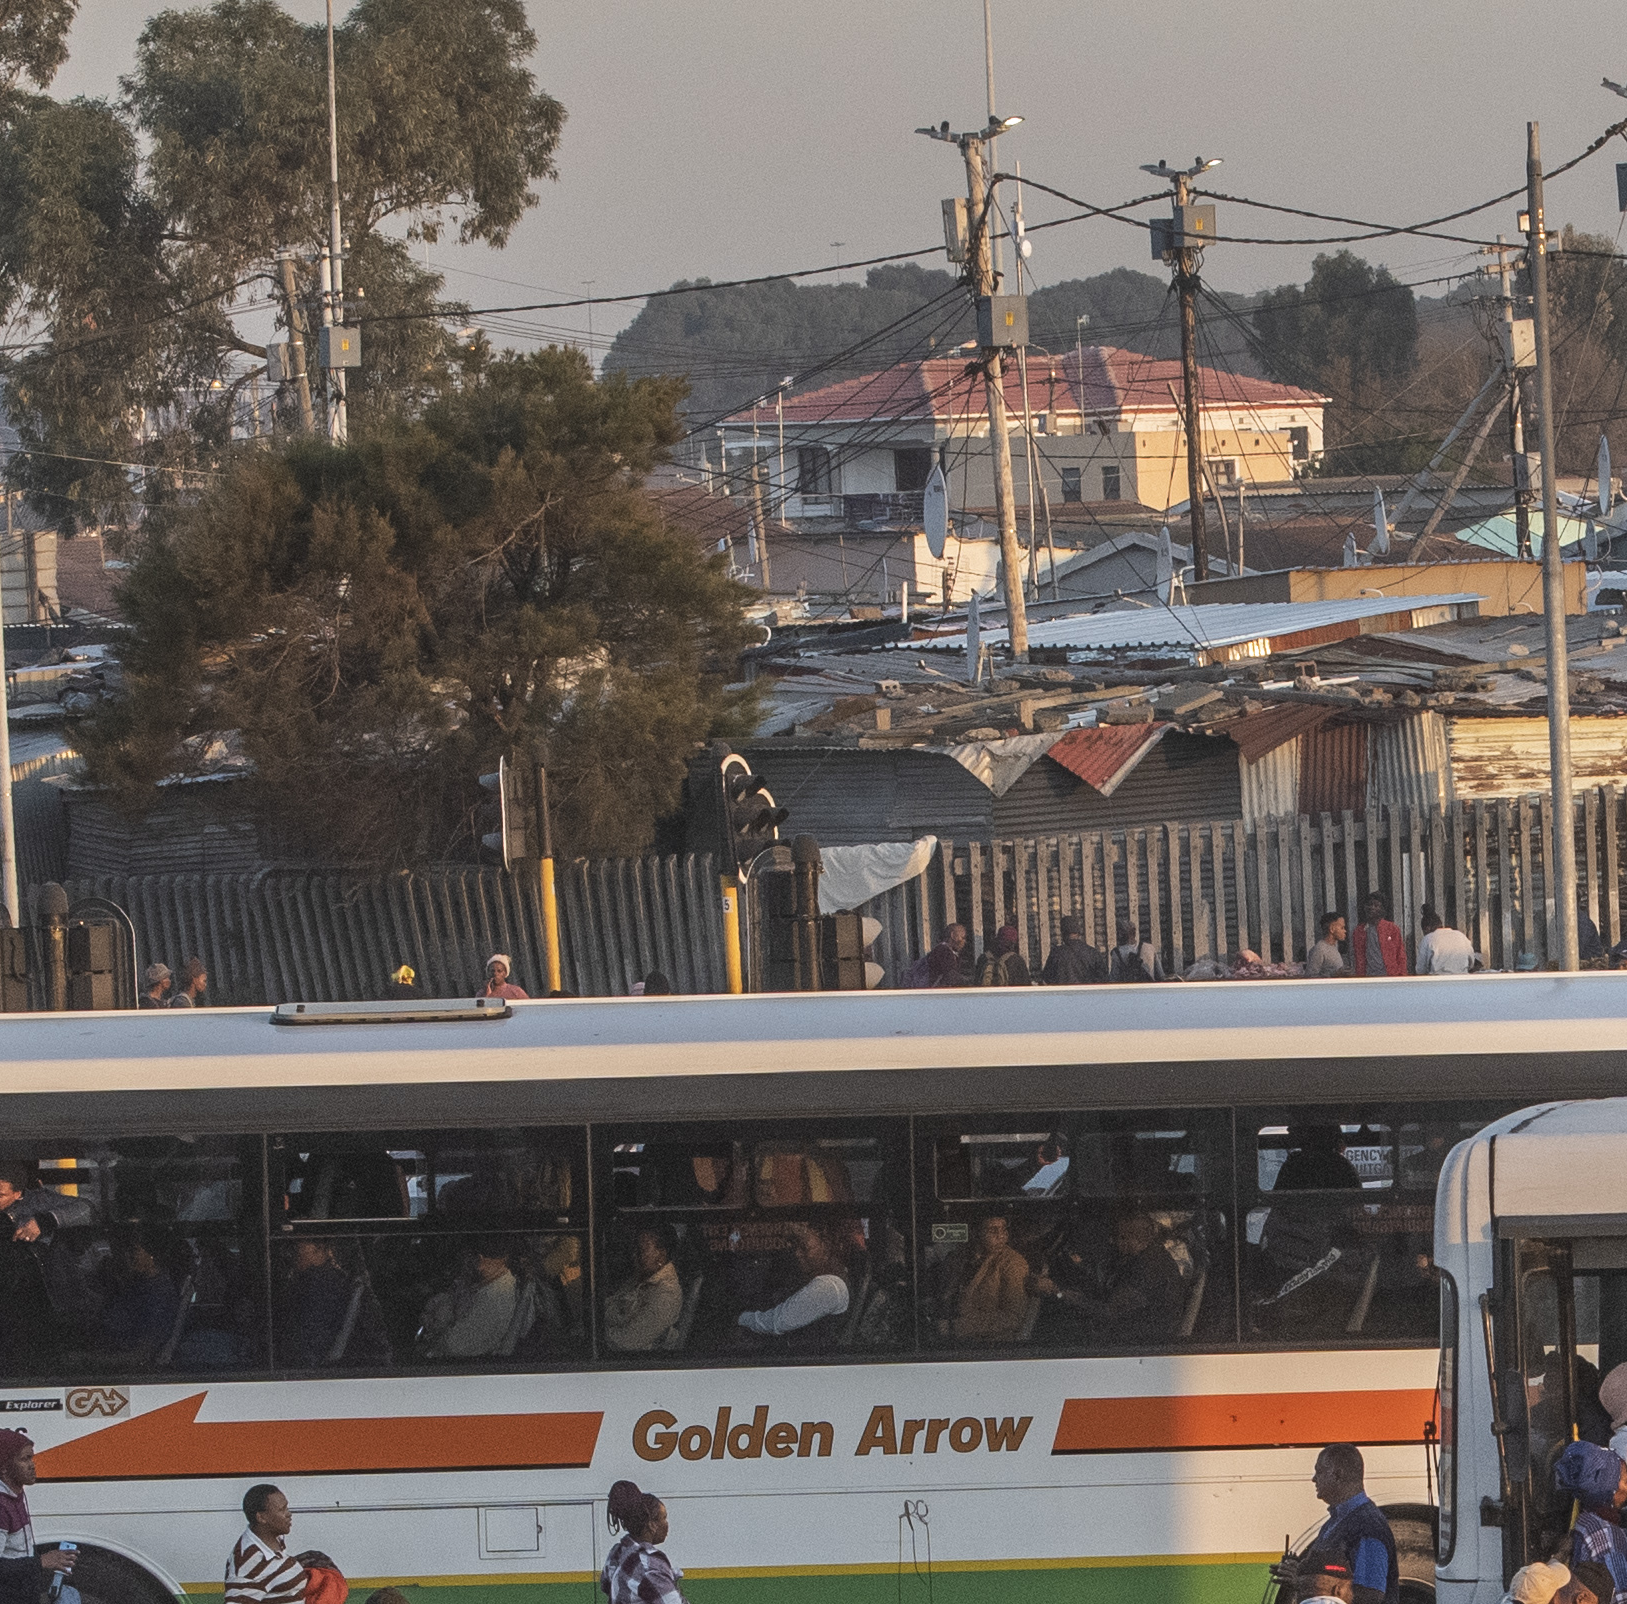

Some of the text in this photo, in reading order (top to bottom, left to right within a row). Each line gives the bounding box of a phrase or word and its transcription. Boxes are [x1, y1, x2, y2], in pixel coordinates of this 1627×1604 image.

[1347, 1149, 1384, 1161] GENCY
[5, 1399, 58, 1412] Explorer
[631, 1403, 1033, 1461] Golden Arrow
